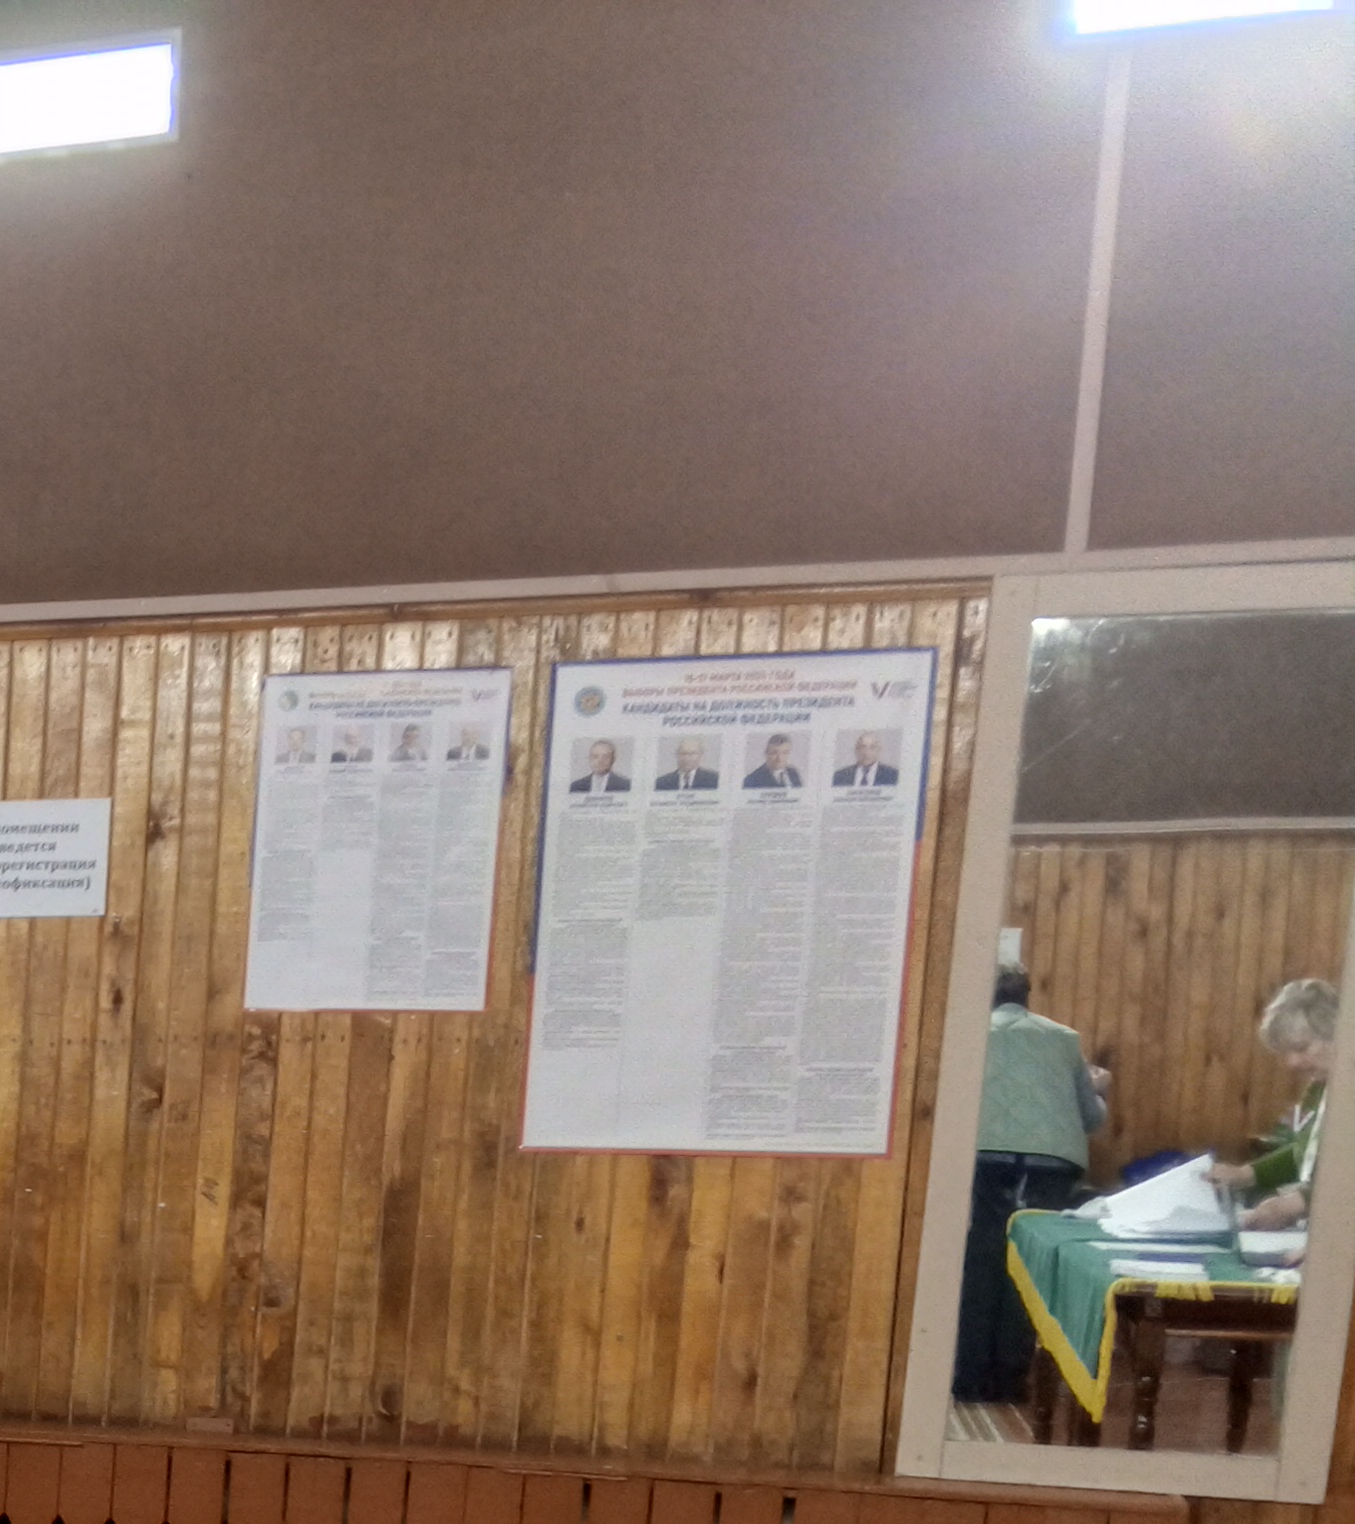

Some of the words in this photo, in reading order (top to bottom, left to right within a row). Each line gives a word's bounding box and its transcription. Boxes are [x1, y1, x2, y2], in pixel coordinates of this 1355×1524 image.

[622, 700, 689, 714] КАНДИДАТЫ
[691, 701, 707, 712] НА
[662, 714, 737, 727] РОССИЙСКОЙ
[740, 712, 811, 725] ФЕДЕРАЦИИ
